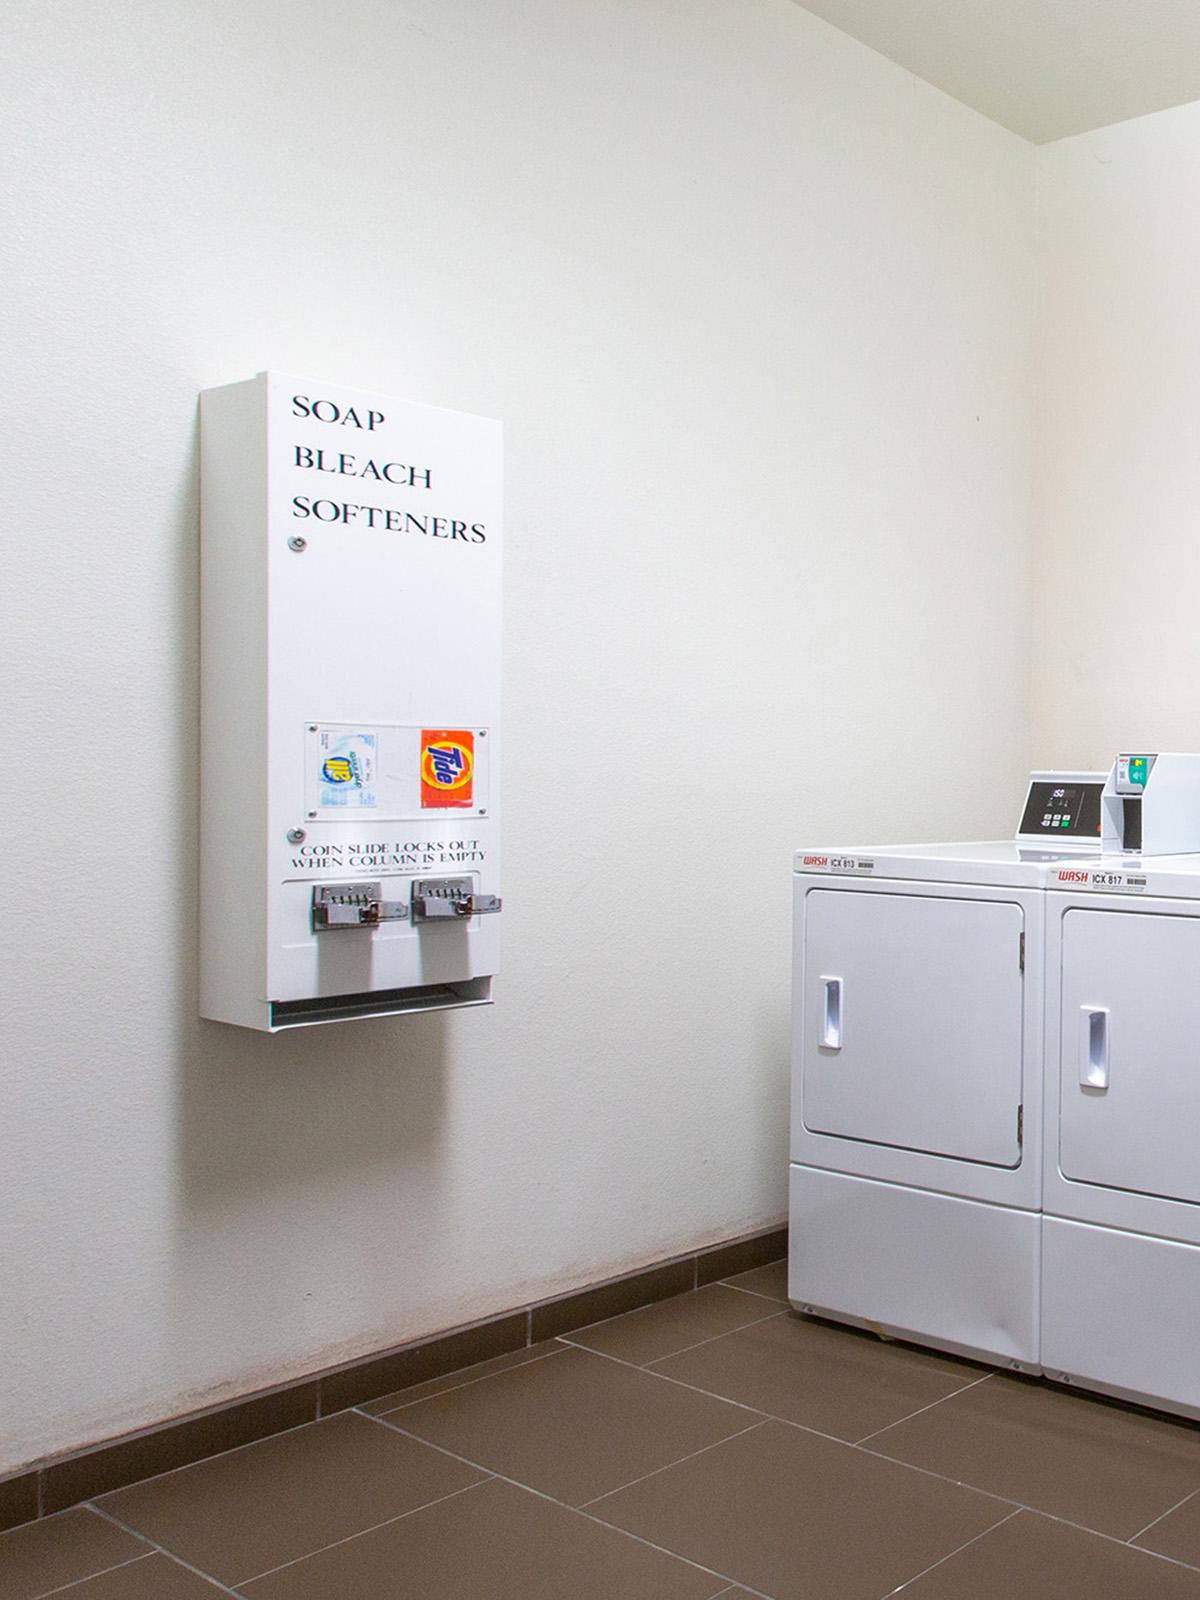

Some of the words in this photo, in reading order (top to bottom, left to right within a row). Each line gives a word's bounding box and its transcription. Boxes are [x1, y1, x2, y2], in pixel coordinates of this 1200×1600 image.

[292, 395, 386, 431] SOAP
[294, 445, 432, 489] BLEACH
[292, 496, 487, 544] SOFTENERS
[326, 759, 352, 782] all
[428, 746, 463, 785] Tide
[300, 845, 343, 856] COIN
[348, 843, 389, 854] SLIDE
[396, 841, 444, 853] LOCKS
[449, 840, 480, 851] OUT
[292, 857, 343, 868] WHEN
[349, 854, 417, 866] COLUMN
[423, 853, 435, 863] IS
[440, 851, 487, 862] EMPTY
[803, 856, 828, 866] WASH
[1058, 871, 1089, 883] WASH
[1092, 874, 1106, 884] ICX
[1108, 876, 1122, 885] 817
